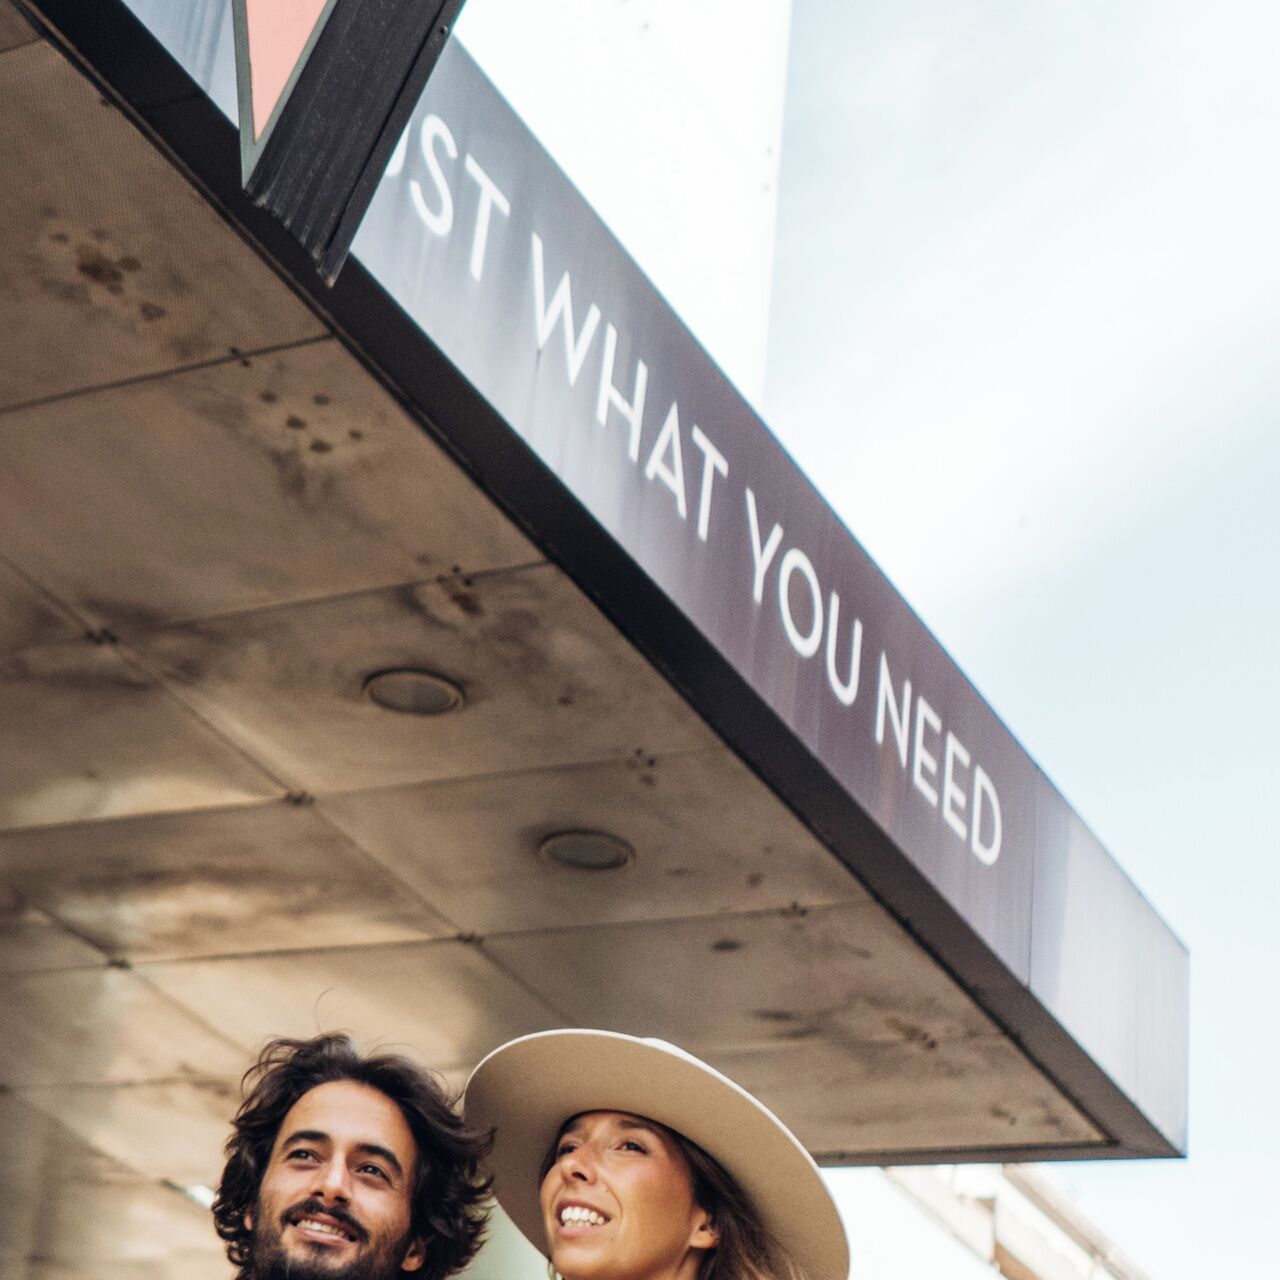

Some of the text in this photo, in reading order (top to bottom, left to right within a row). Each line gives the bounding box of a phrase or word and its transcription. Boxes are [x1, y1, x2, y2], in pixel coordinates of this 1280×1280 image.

[531, 230, 730, 543] WHAT
[745, 486, 863, 707] YOU
[875, 651, 1003, 866] NEED
